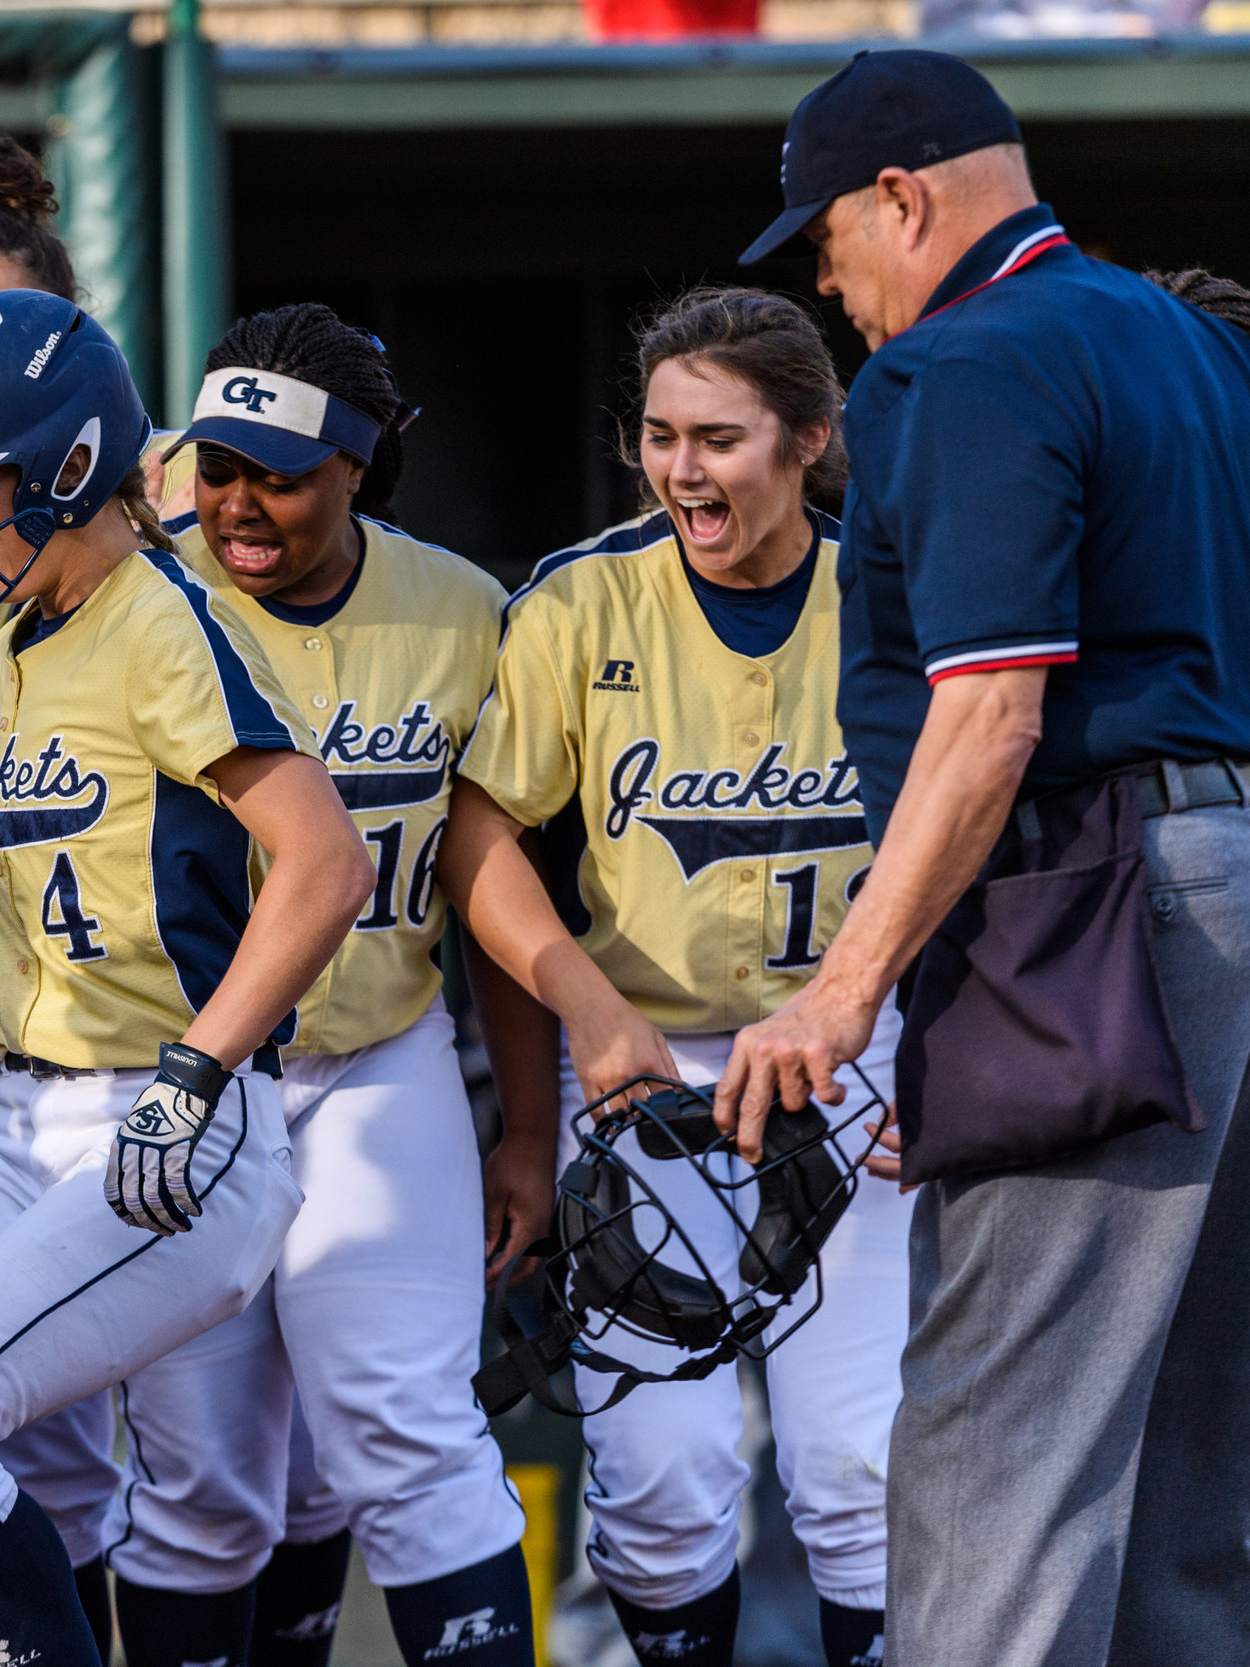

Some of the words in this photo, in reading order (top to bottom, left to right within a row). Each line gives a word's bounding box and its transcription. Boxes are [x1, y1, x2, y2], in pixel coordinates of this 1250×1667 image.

[24, 331, 62, 379] Wilson
[222, 376, 277, 413] GT
[592, 682, 640, 693] RUSSELL
[605, 737, 863, 840] Jacket
[40, 849, 109, 963] 4
